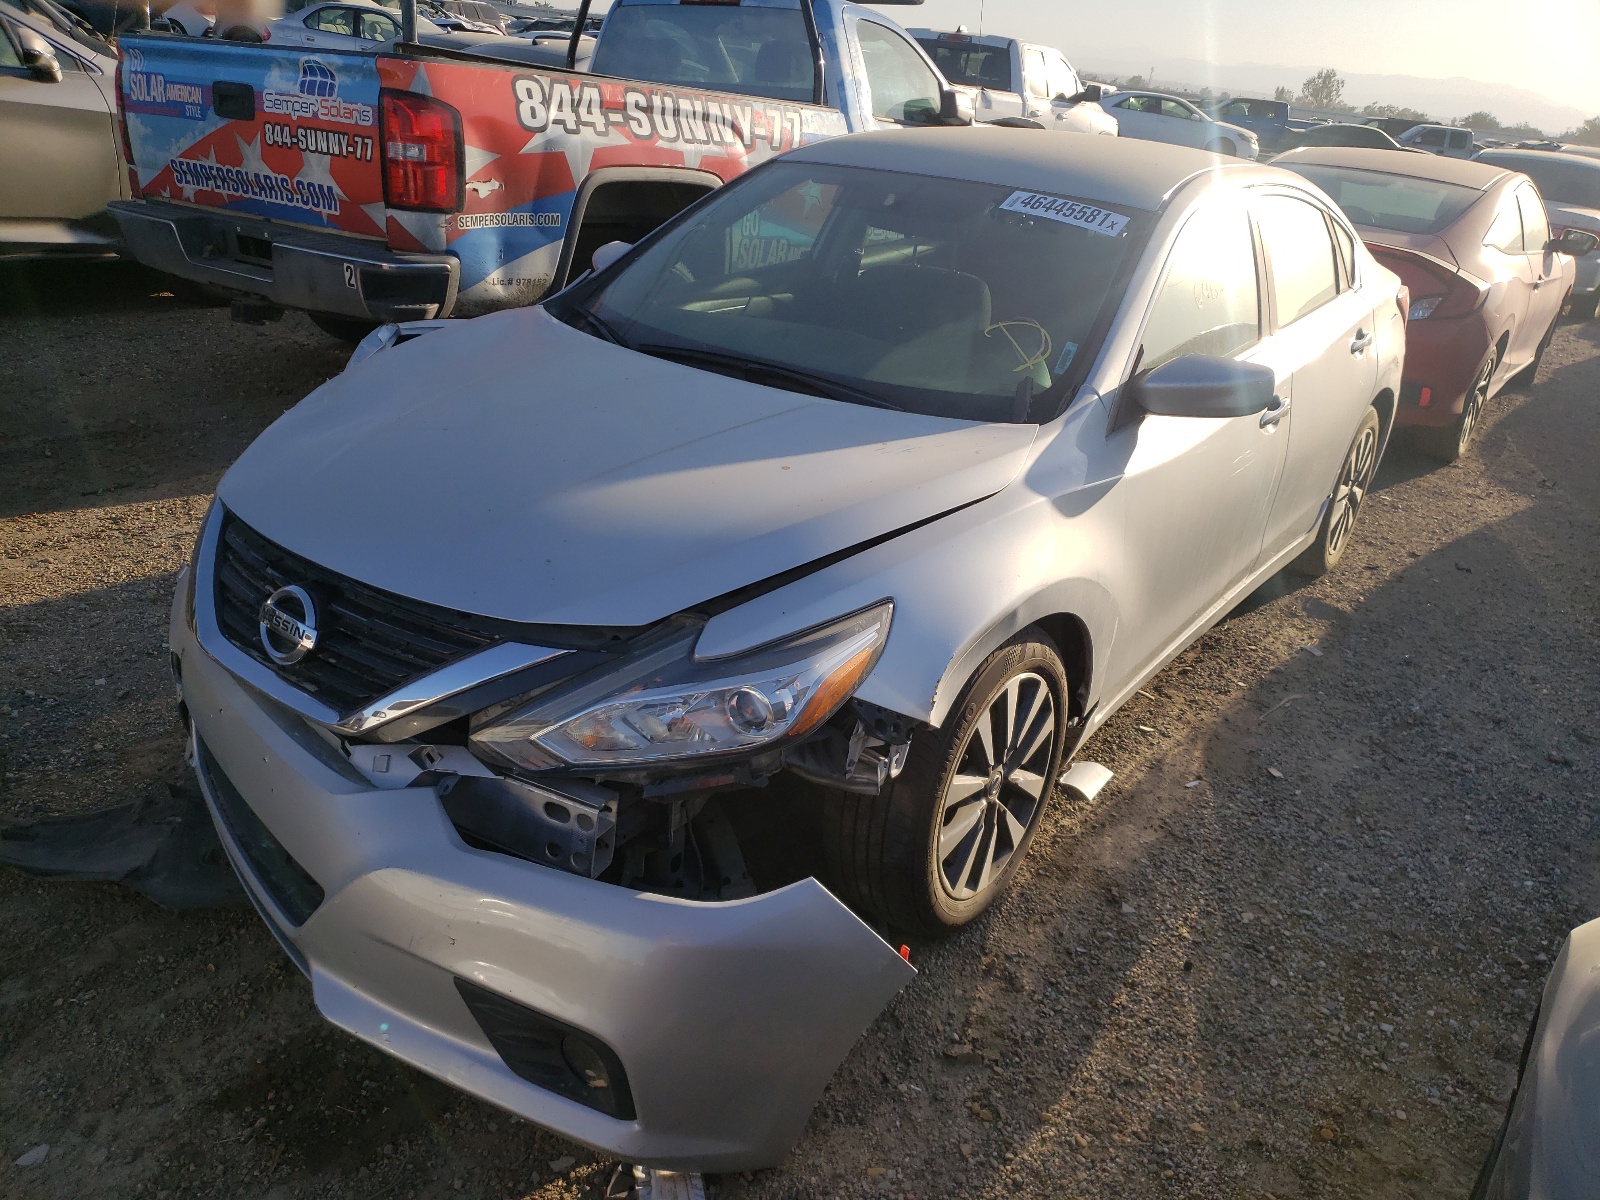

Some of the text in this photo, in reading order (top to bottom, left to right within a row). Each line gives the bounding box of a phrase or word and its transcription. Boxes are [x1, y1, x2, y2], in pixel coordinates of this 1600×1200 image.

[130, 73, 202, 104] SOLAR AMERICAN
[185, 104, 202, 118] STYLE
[264, 91, 371, 123] Semper Solaris
[512, 77, 804, 149] 844-SUNNY-77
[263, 122, 373, 162] 844-SUNNY-77
[169, 157, 340, 214] SEMPERSOLARIS.COM
[458, 213, 561, 229] SEMPERSOLARIS.COM
[1021, 194, 1112, 227] 46445581
[344, 265, 356, 289] 2
